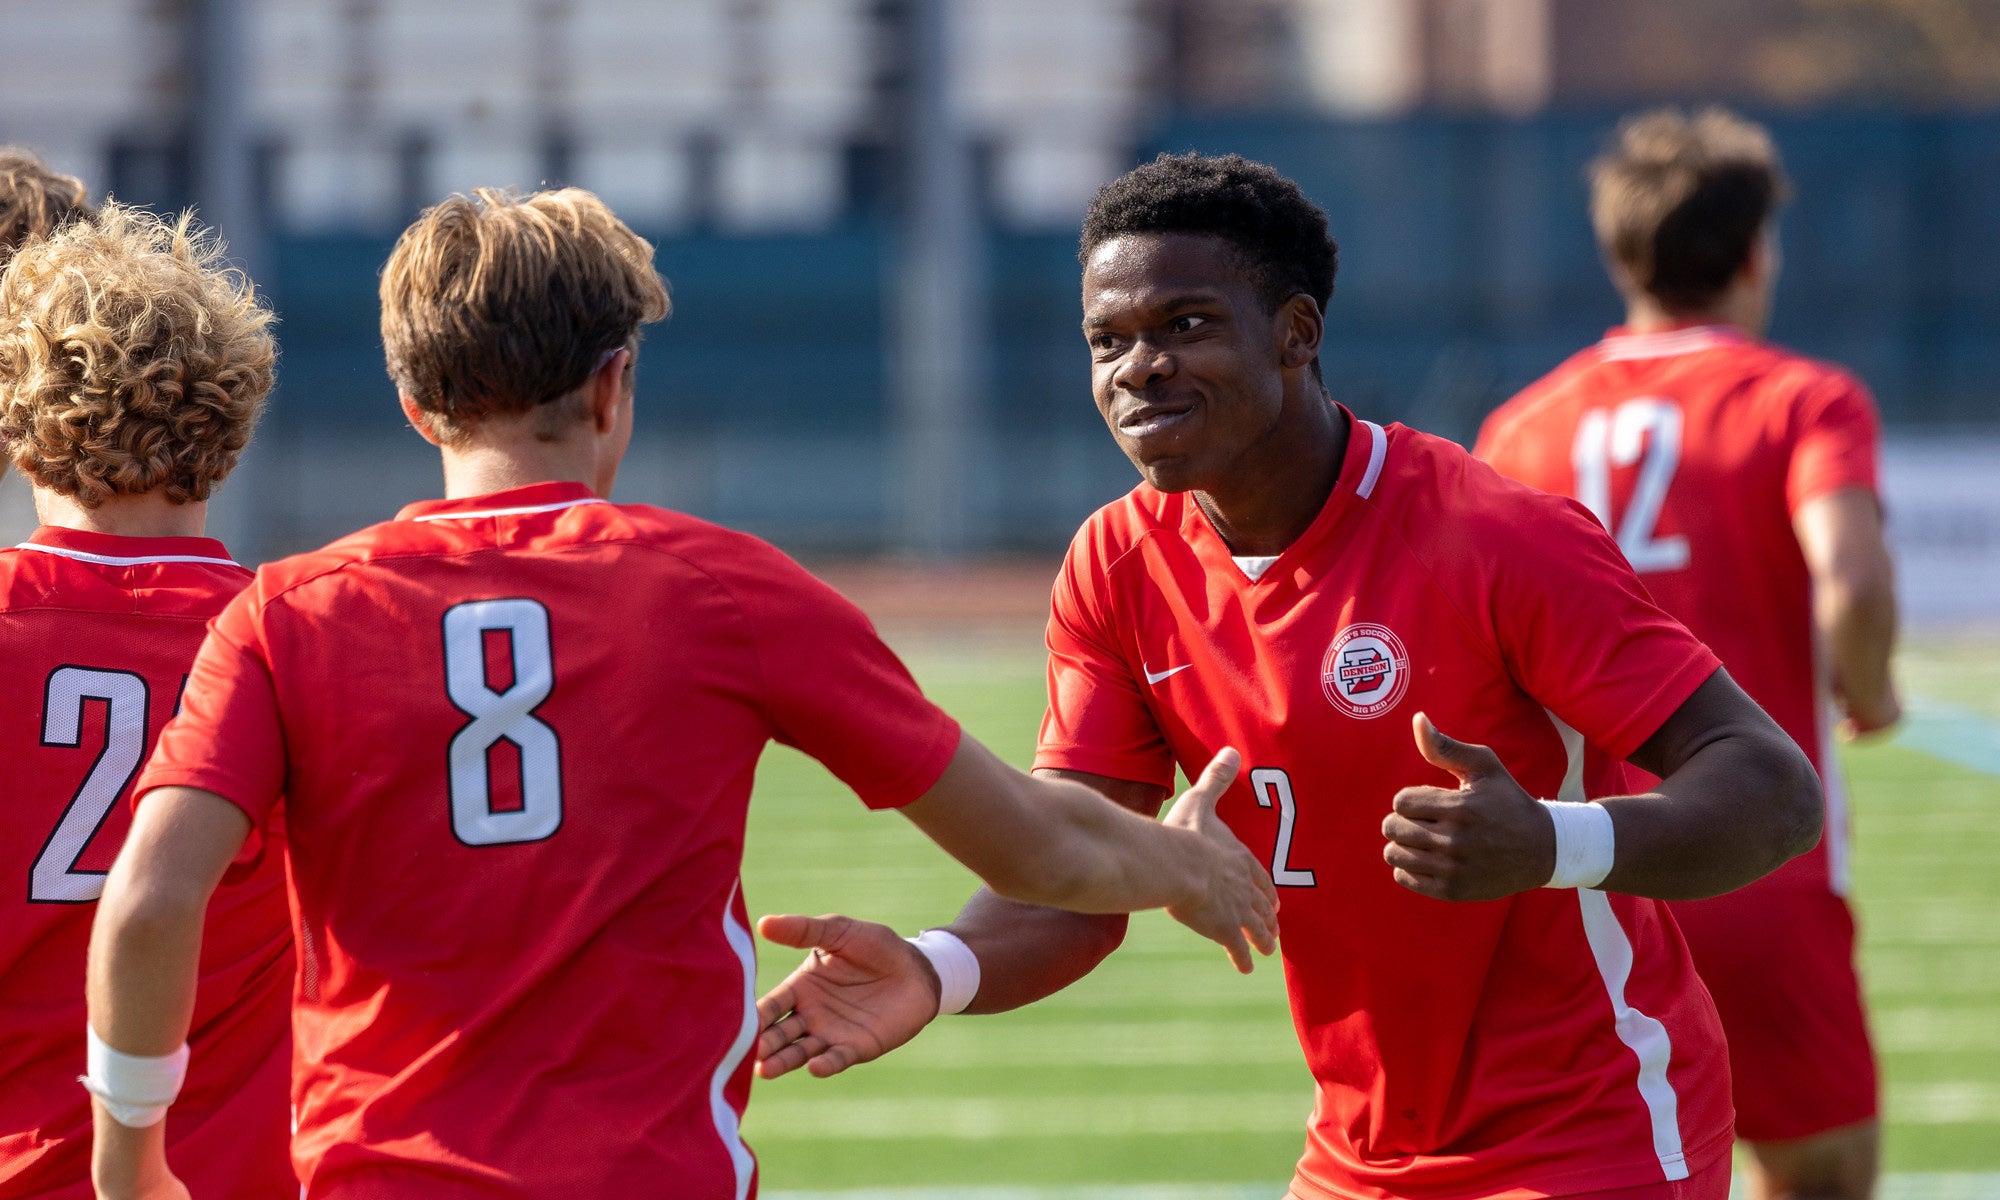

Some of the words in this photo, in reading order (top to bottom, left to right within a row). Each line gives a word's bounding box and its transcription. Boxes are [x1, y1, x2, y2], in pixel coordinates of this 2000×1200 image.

[1570, 397, 1691, 574] 12
[1334, 630, 1358, 652] MEN'S
[1360, 629, 1390, 642] SOCCER
[1343, 662, 1386, 677] DENISON
[442, 597, 562, 847] 8
[1352, 705, 1368, 714] BIG
[1369, 700, 1387, 712] RED
[27, 663, 189, 904] 2
[1250, 766, 1316, 888] 2
